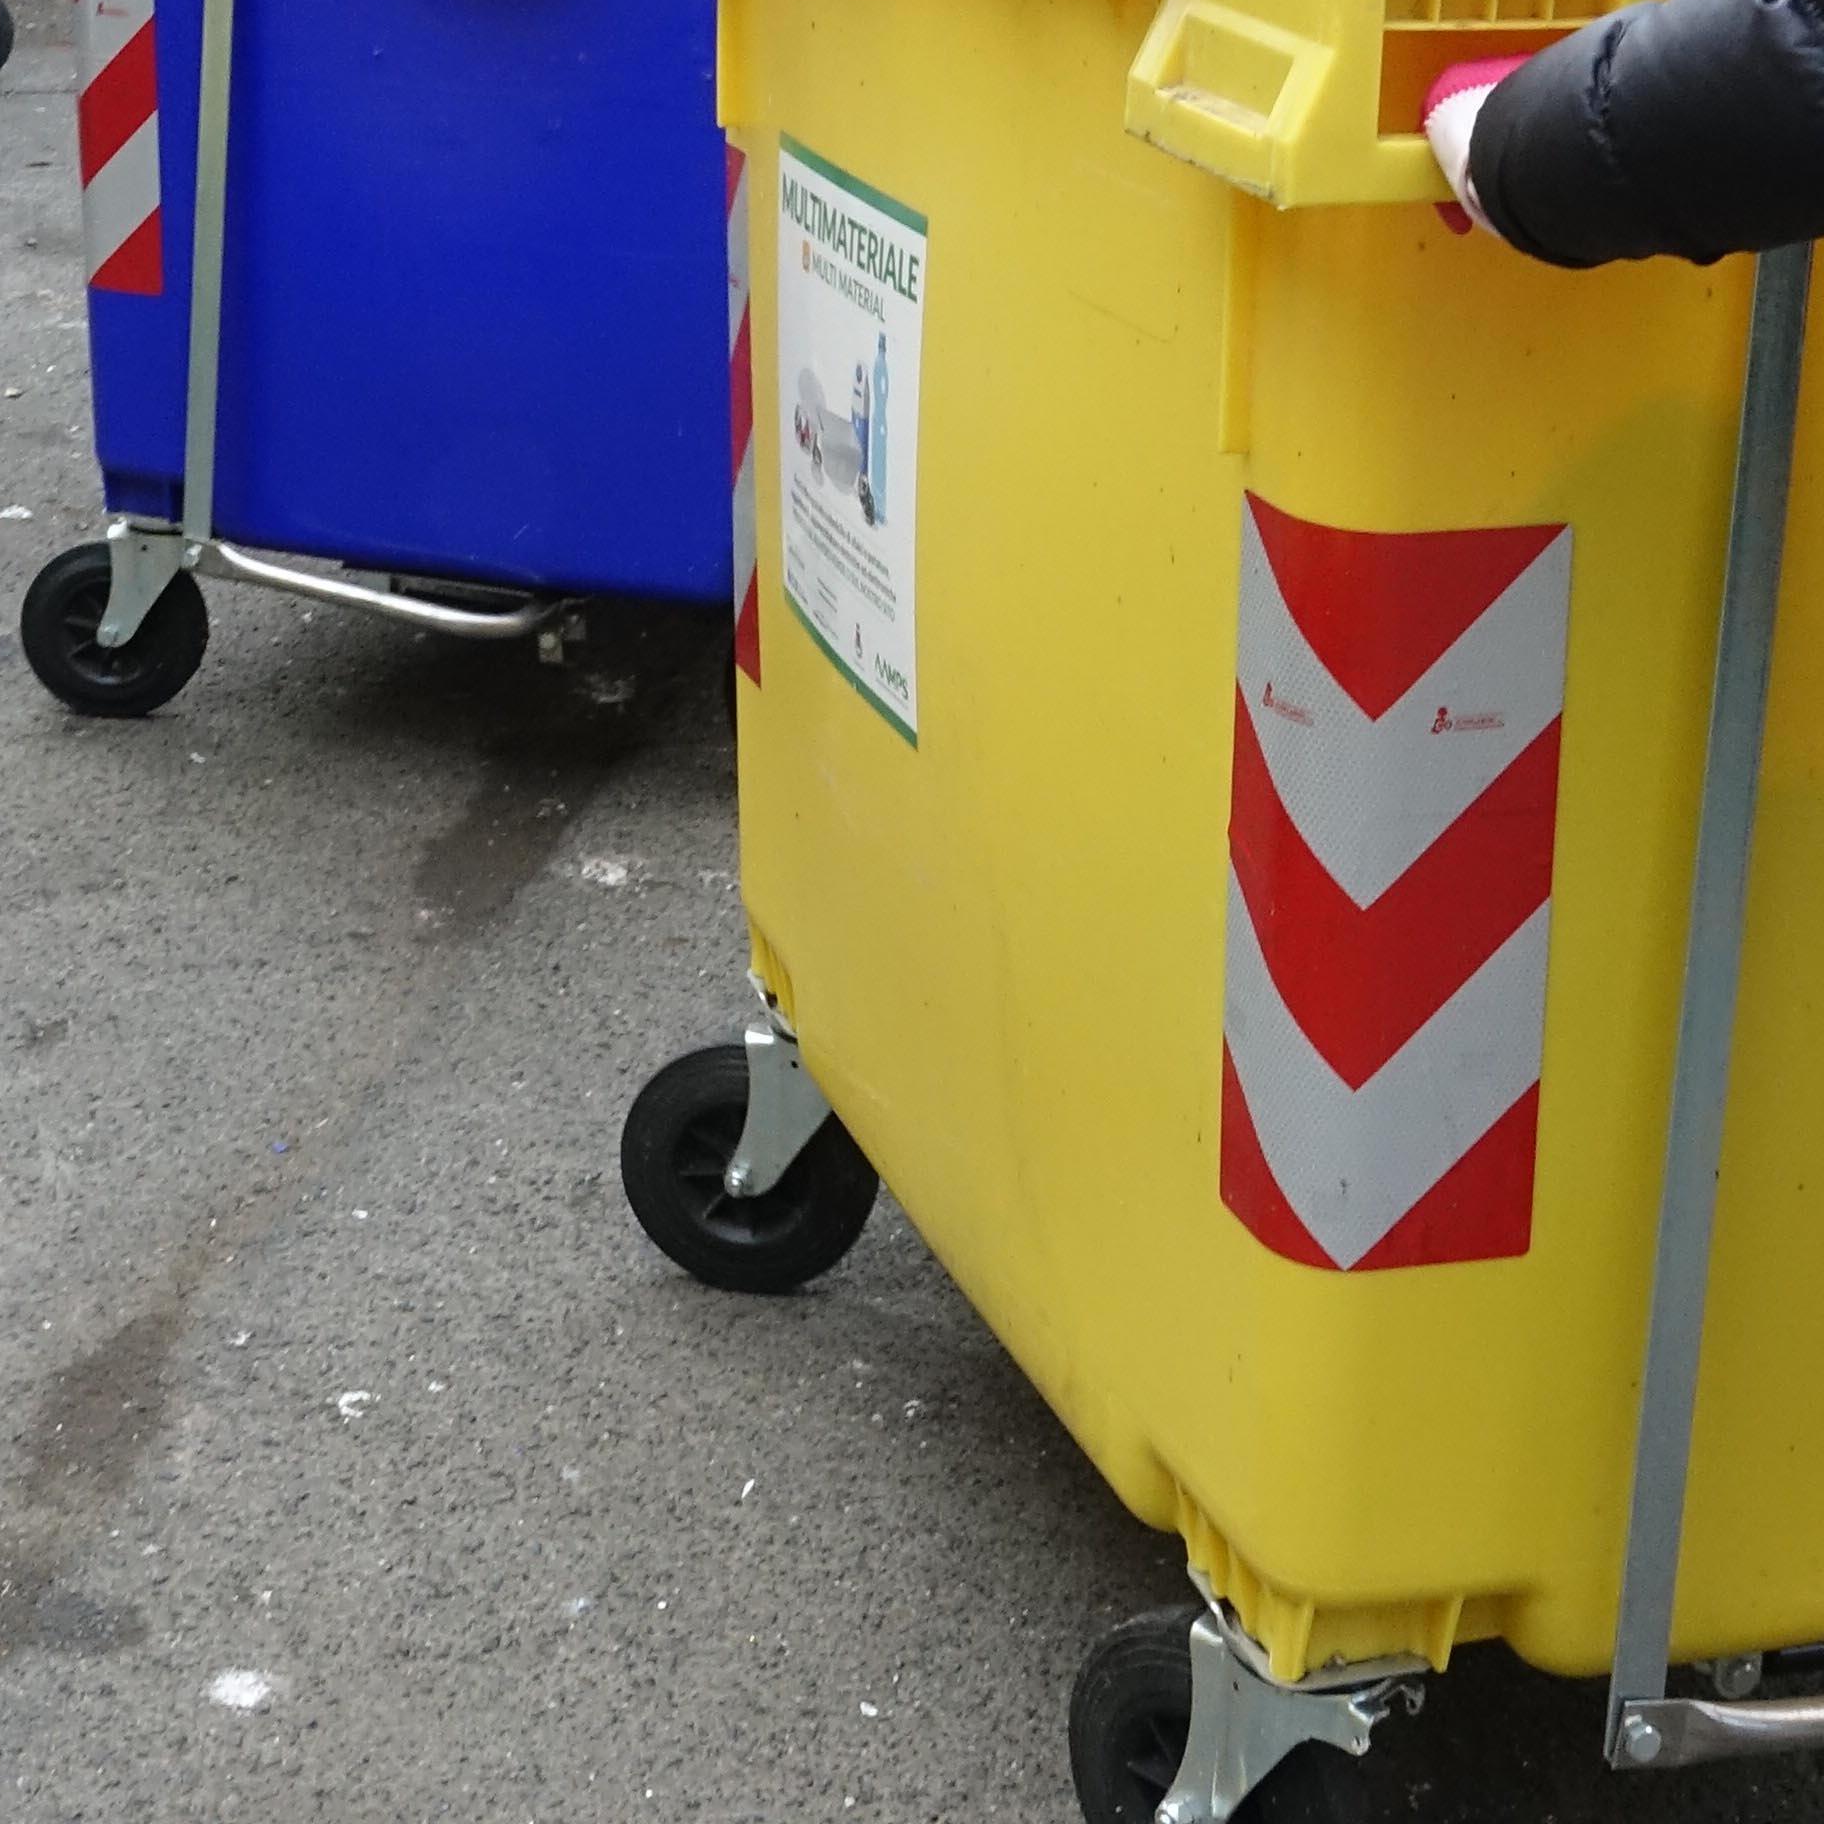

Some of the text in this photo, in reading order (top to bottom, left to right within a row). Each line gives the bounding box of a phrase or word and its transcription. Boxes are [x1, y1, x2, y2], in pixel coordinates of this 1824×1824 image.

[782, 174, 919, 305] MULTIMATERIALE
[812, 250, 885, 323] MULTI MATERIAL
